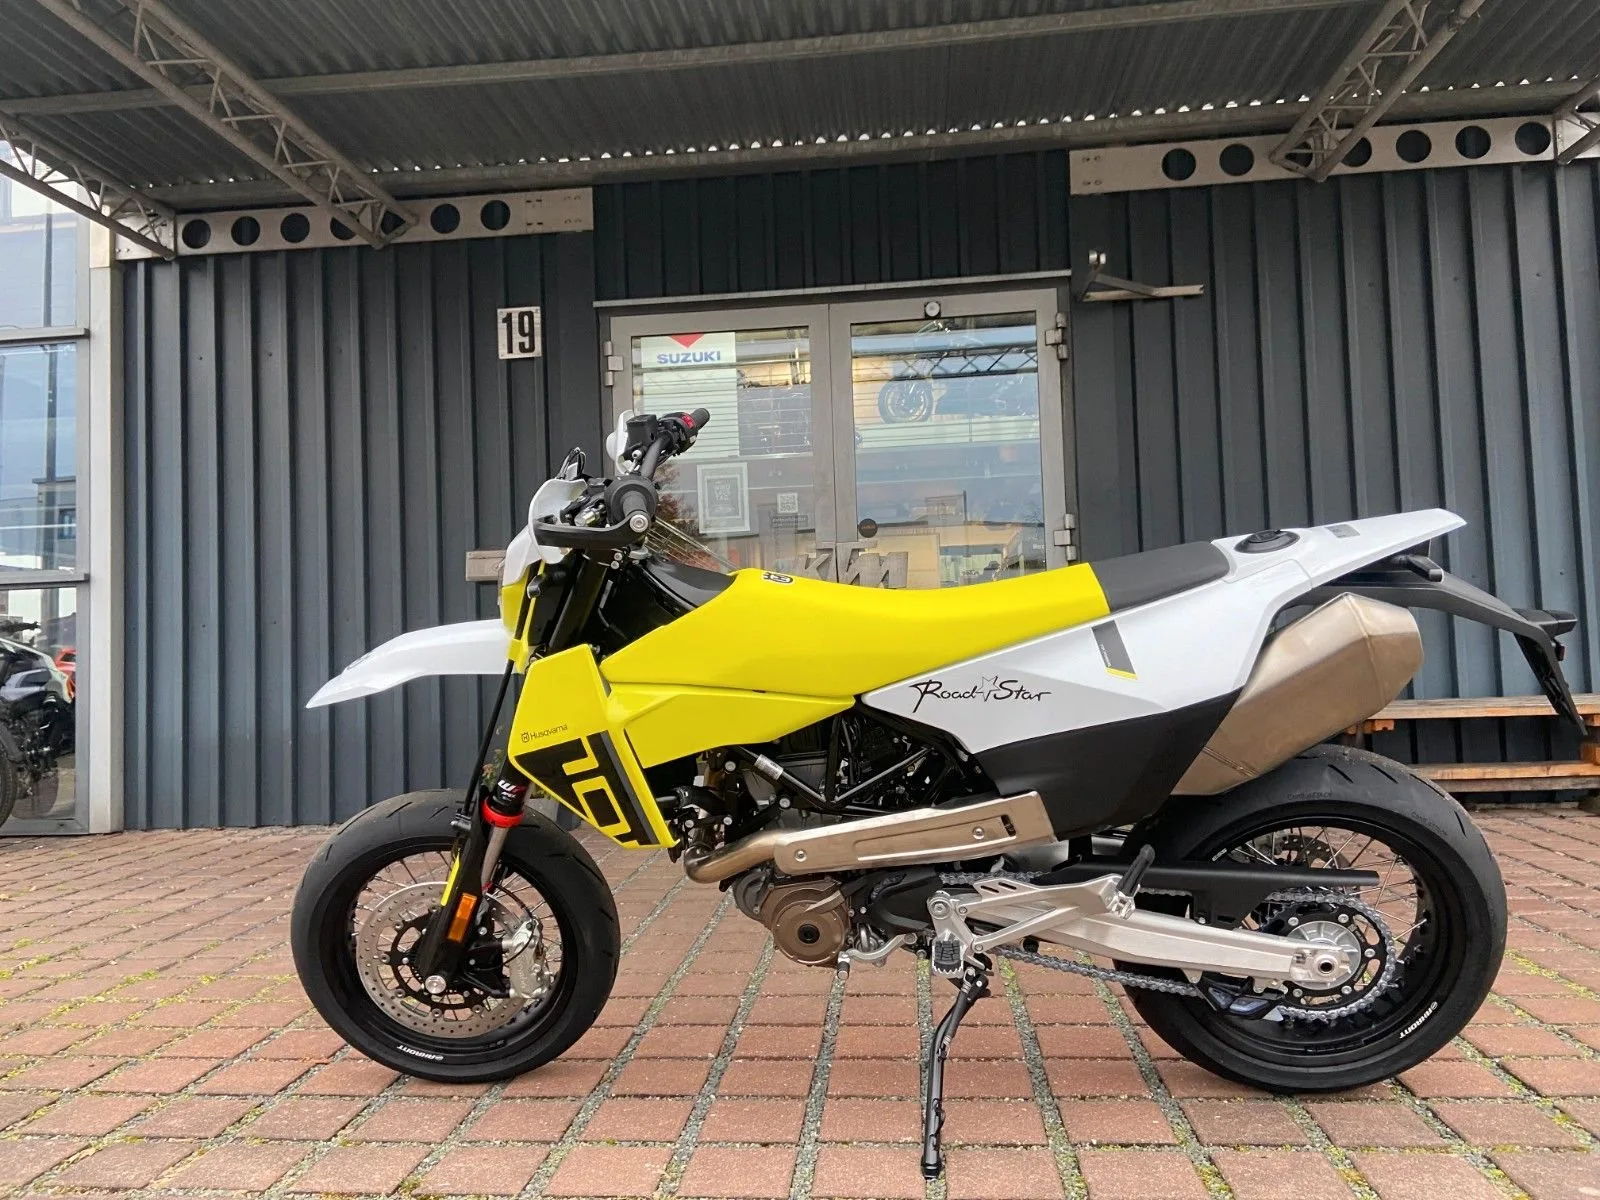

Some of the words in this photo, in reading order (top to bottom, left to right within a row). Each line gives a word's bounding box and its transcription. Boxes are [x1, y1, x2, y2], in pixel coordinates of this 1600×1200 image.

[502, 311, 535, 354] 19
[656, 351, 721, 364] SUZUKI
[908, 679, 977, 713] Road
[993, 680, 1052, 701] Star
[530, 724, 568, 740] Husqvarna
